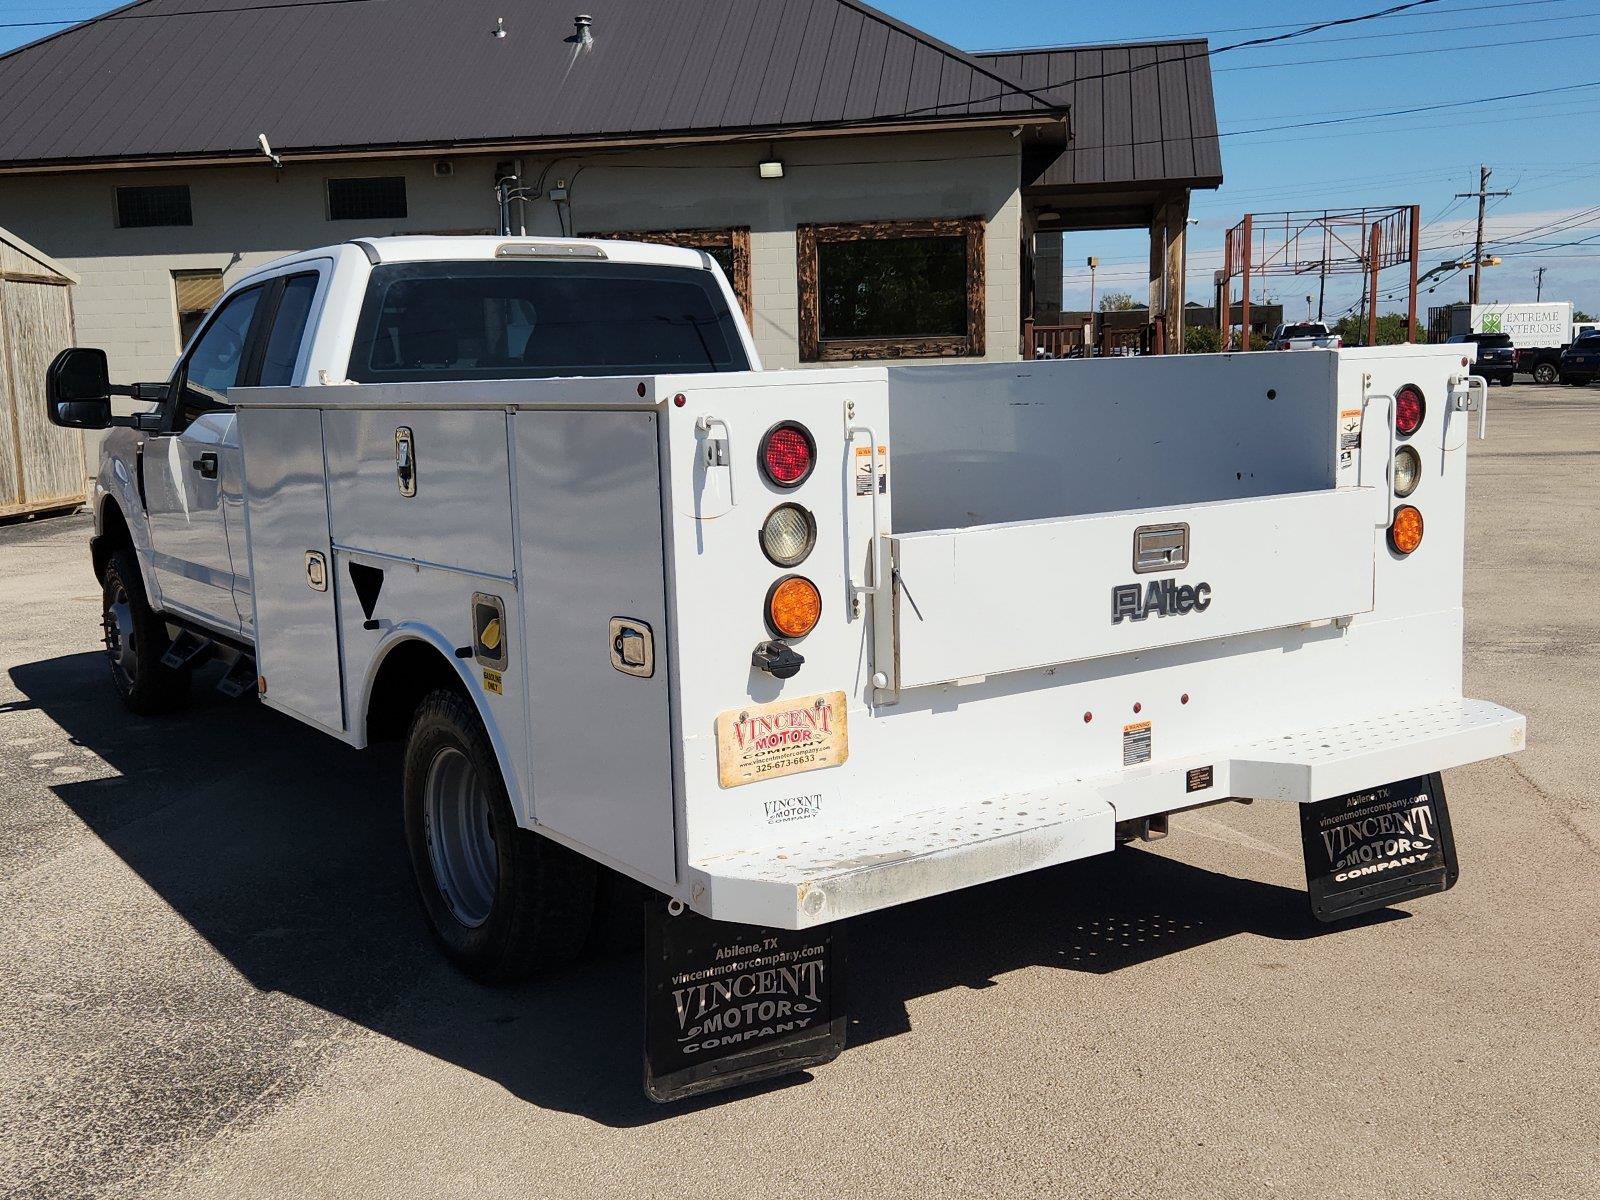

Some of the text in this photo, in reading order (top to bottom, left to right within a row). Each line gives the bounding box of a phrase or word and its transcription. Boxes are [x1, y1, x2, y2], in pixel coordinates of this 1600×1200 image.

[1504, 323, 1561, 334] EXTERIORS
[1507, 312, 1558, 322] EXTREME
[1142, 578, 1211, 619] Altec
[487, 681, 499, 691] ONLY
[733, 704, 832, 750] VINCENT
[743, 740, 825, 760] COMPANY
[756, 729, 812, 751] MOTOR
[739, 745, 831, 768] www.vincentmotorcompany.com
[756, 754, 815, 773] 325-673-6633
[764, 794, 822, 816] VINCENT
[1346, 788, 1389, 808] Abilene, TX
[768, 813, 818, 825] COMPANY
[776, 807, 810, 819] MOTOR
[1319, 793, 1429, 827] vincentmotorcompany.com
[1320, 805, 1435, 863] VINCENT
[1346, 838, 1412, 866] MOTOR
[1335, 852, 1429, 882] COMPANY
[715, 937, 779, 960] Abilene, TX
[671, 944, 825, 986] vincentmotorcompany.com
[671, 959, 825, 1030] VINCENT
[703, 1000, 792, 1034] MOTOR
[682, 1017, 812, 1054] COMPANY
